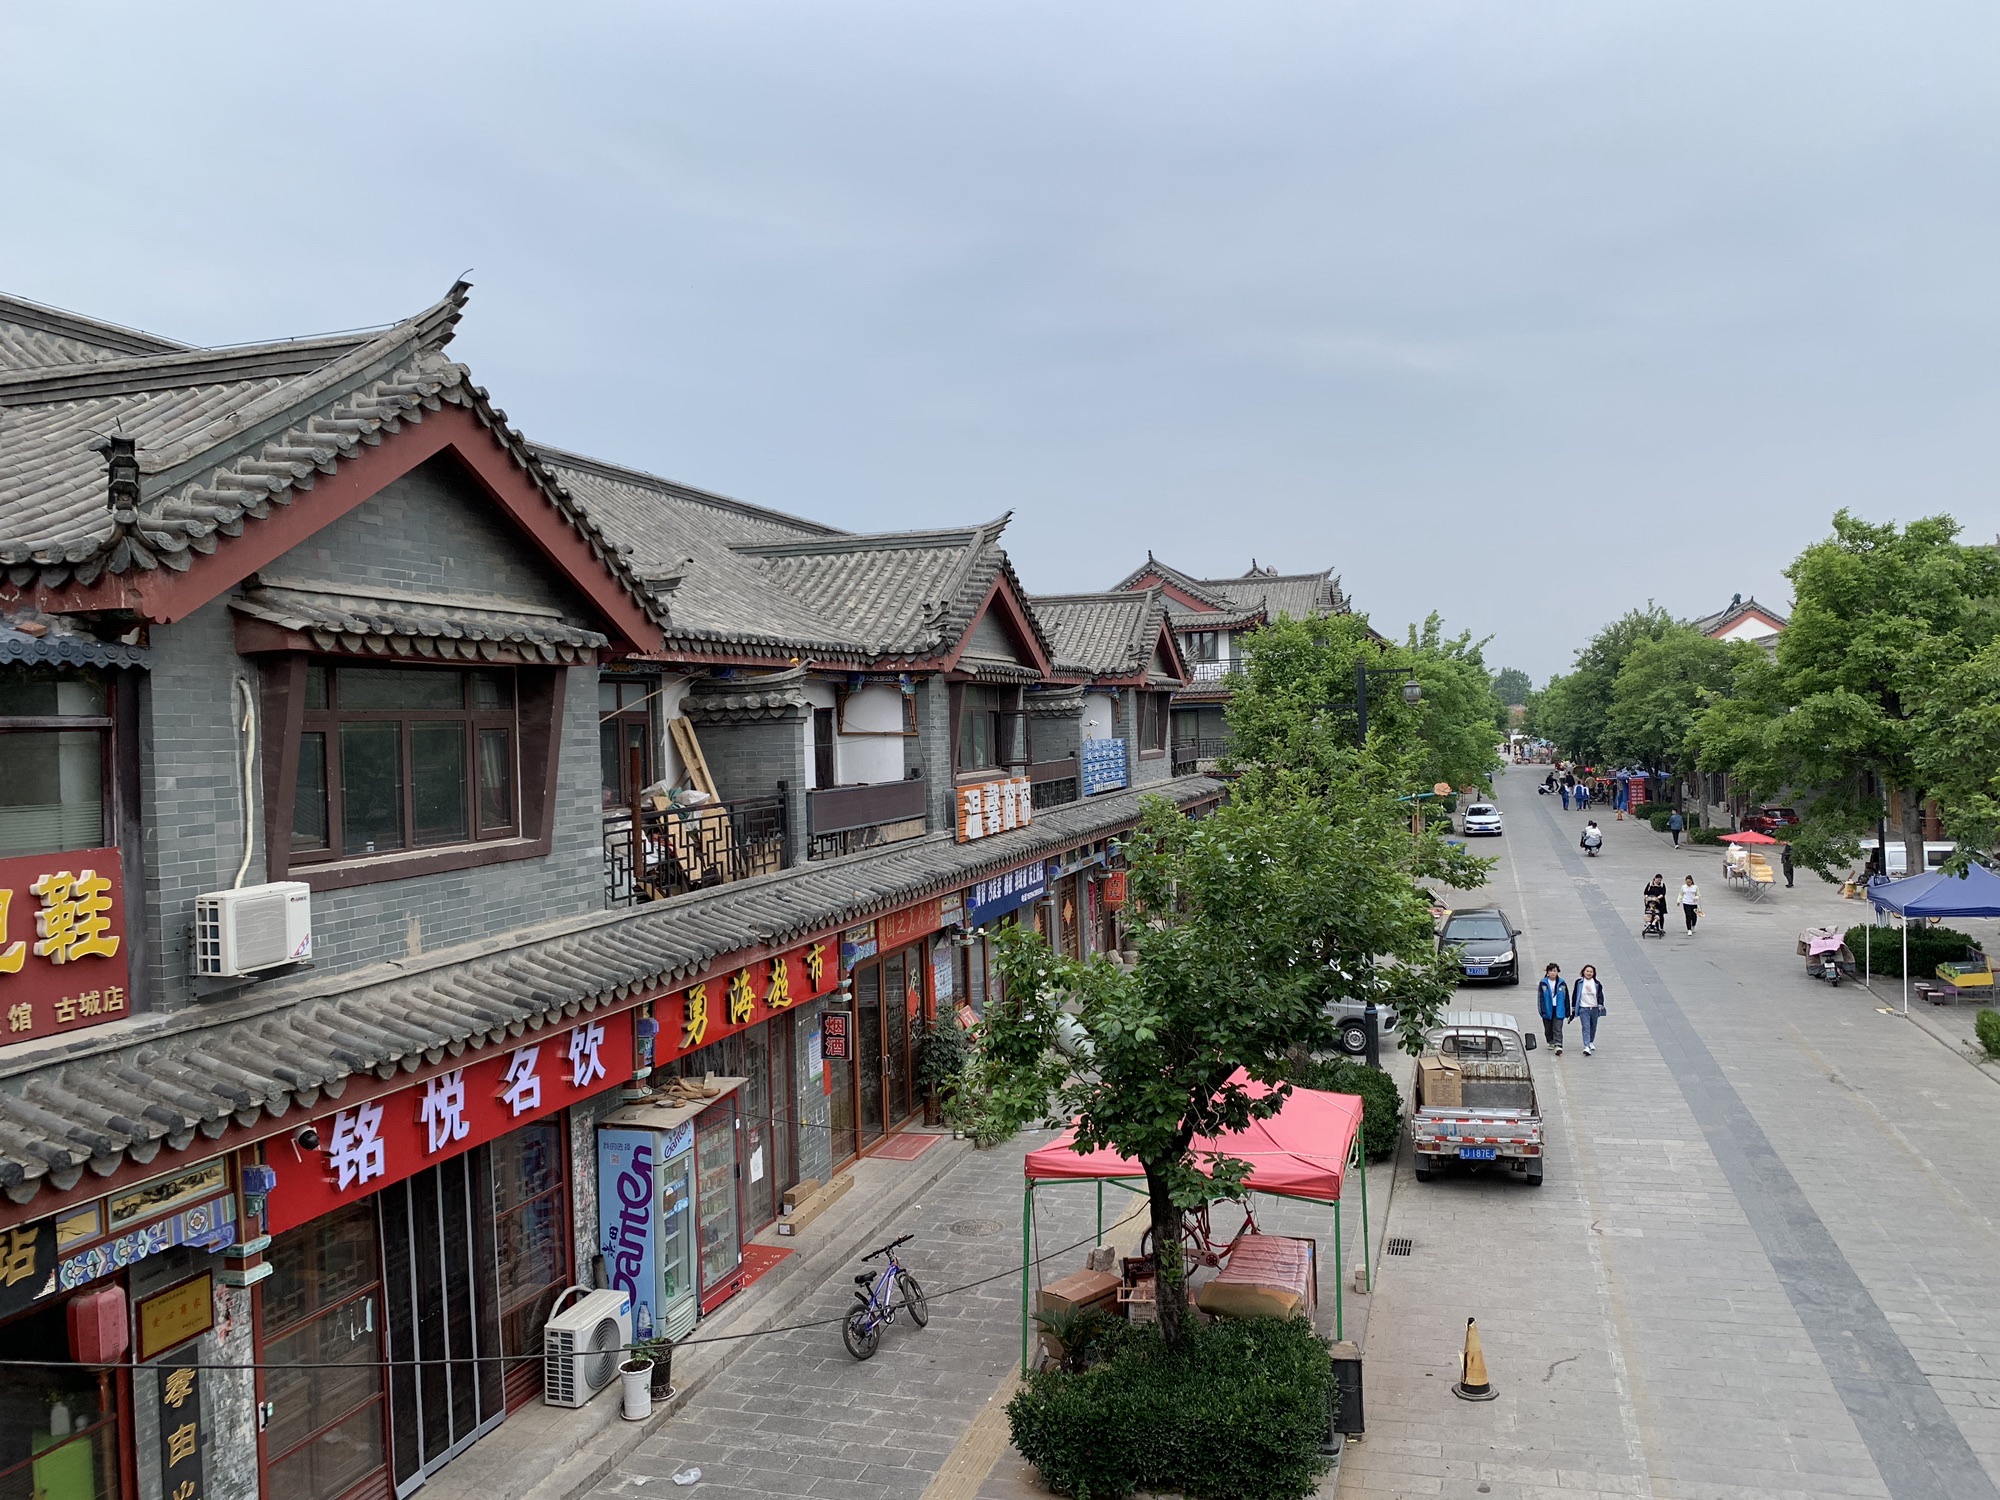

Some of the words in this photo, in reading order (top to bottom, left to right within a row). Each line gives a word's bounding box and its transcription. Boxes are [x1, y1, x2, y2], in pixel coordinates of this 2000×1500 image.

[964, 778, 1031, 839] 温馨窗帘
[0, 1002, 33, 1034] 馆
[54, 986, 124, 1024] 古城店
[680, 943, 826, 1049] 勇海超市
[825, 1016, 846, 1057] 烟酒
[328, 1021, 606, 1192] 铭悦名饮
[603, 1142, 631, 1152] 我的选择
